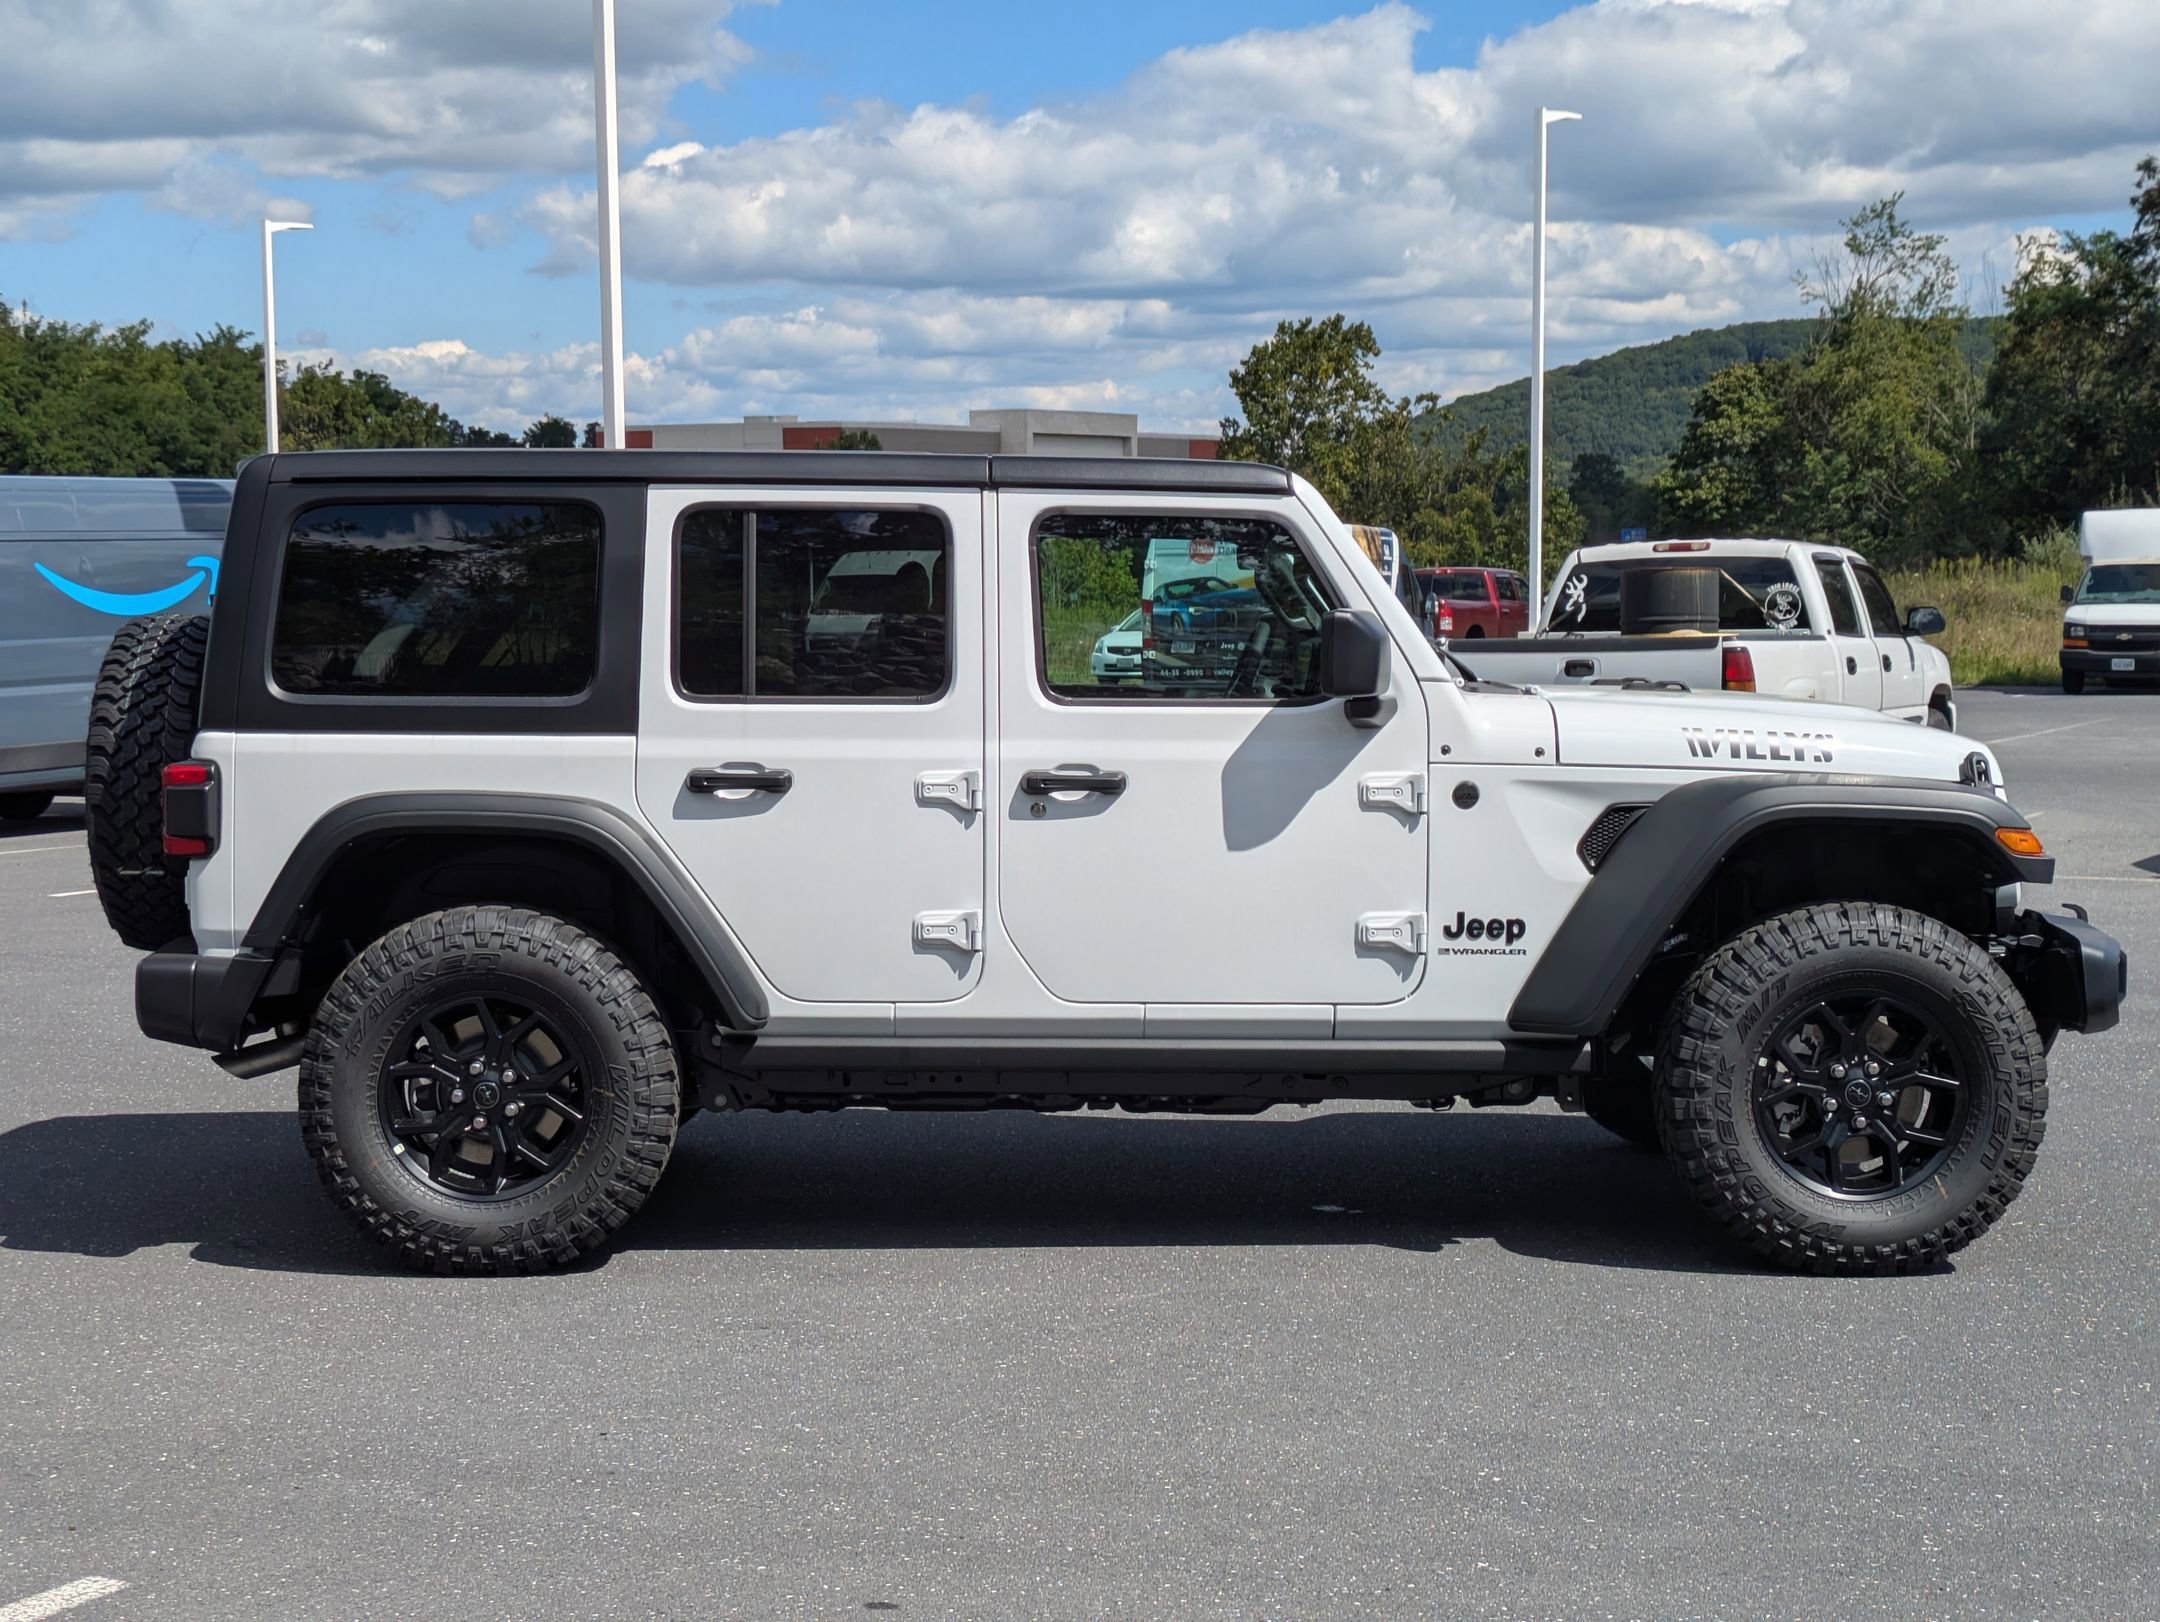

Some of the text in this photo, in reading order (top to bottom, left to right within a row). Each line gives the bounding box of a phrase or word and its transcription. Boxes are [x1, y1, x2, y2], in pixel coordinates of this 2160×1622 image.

[1681, 727, 1834, 763] WILLYS
[1443, 911, 1527, 947] Jeep
[1451, 948, 1528, 956] WRANGLER
[345, 952, 503, 1057] FALKEN
[1714, 973, 1847, 1243] WILDPEAK M/T
[1951, 986, 2015, 1171] FALKEN
[393, 1063, 631, 1245] WILDPEAK M/T
